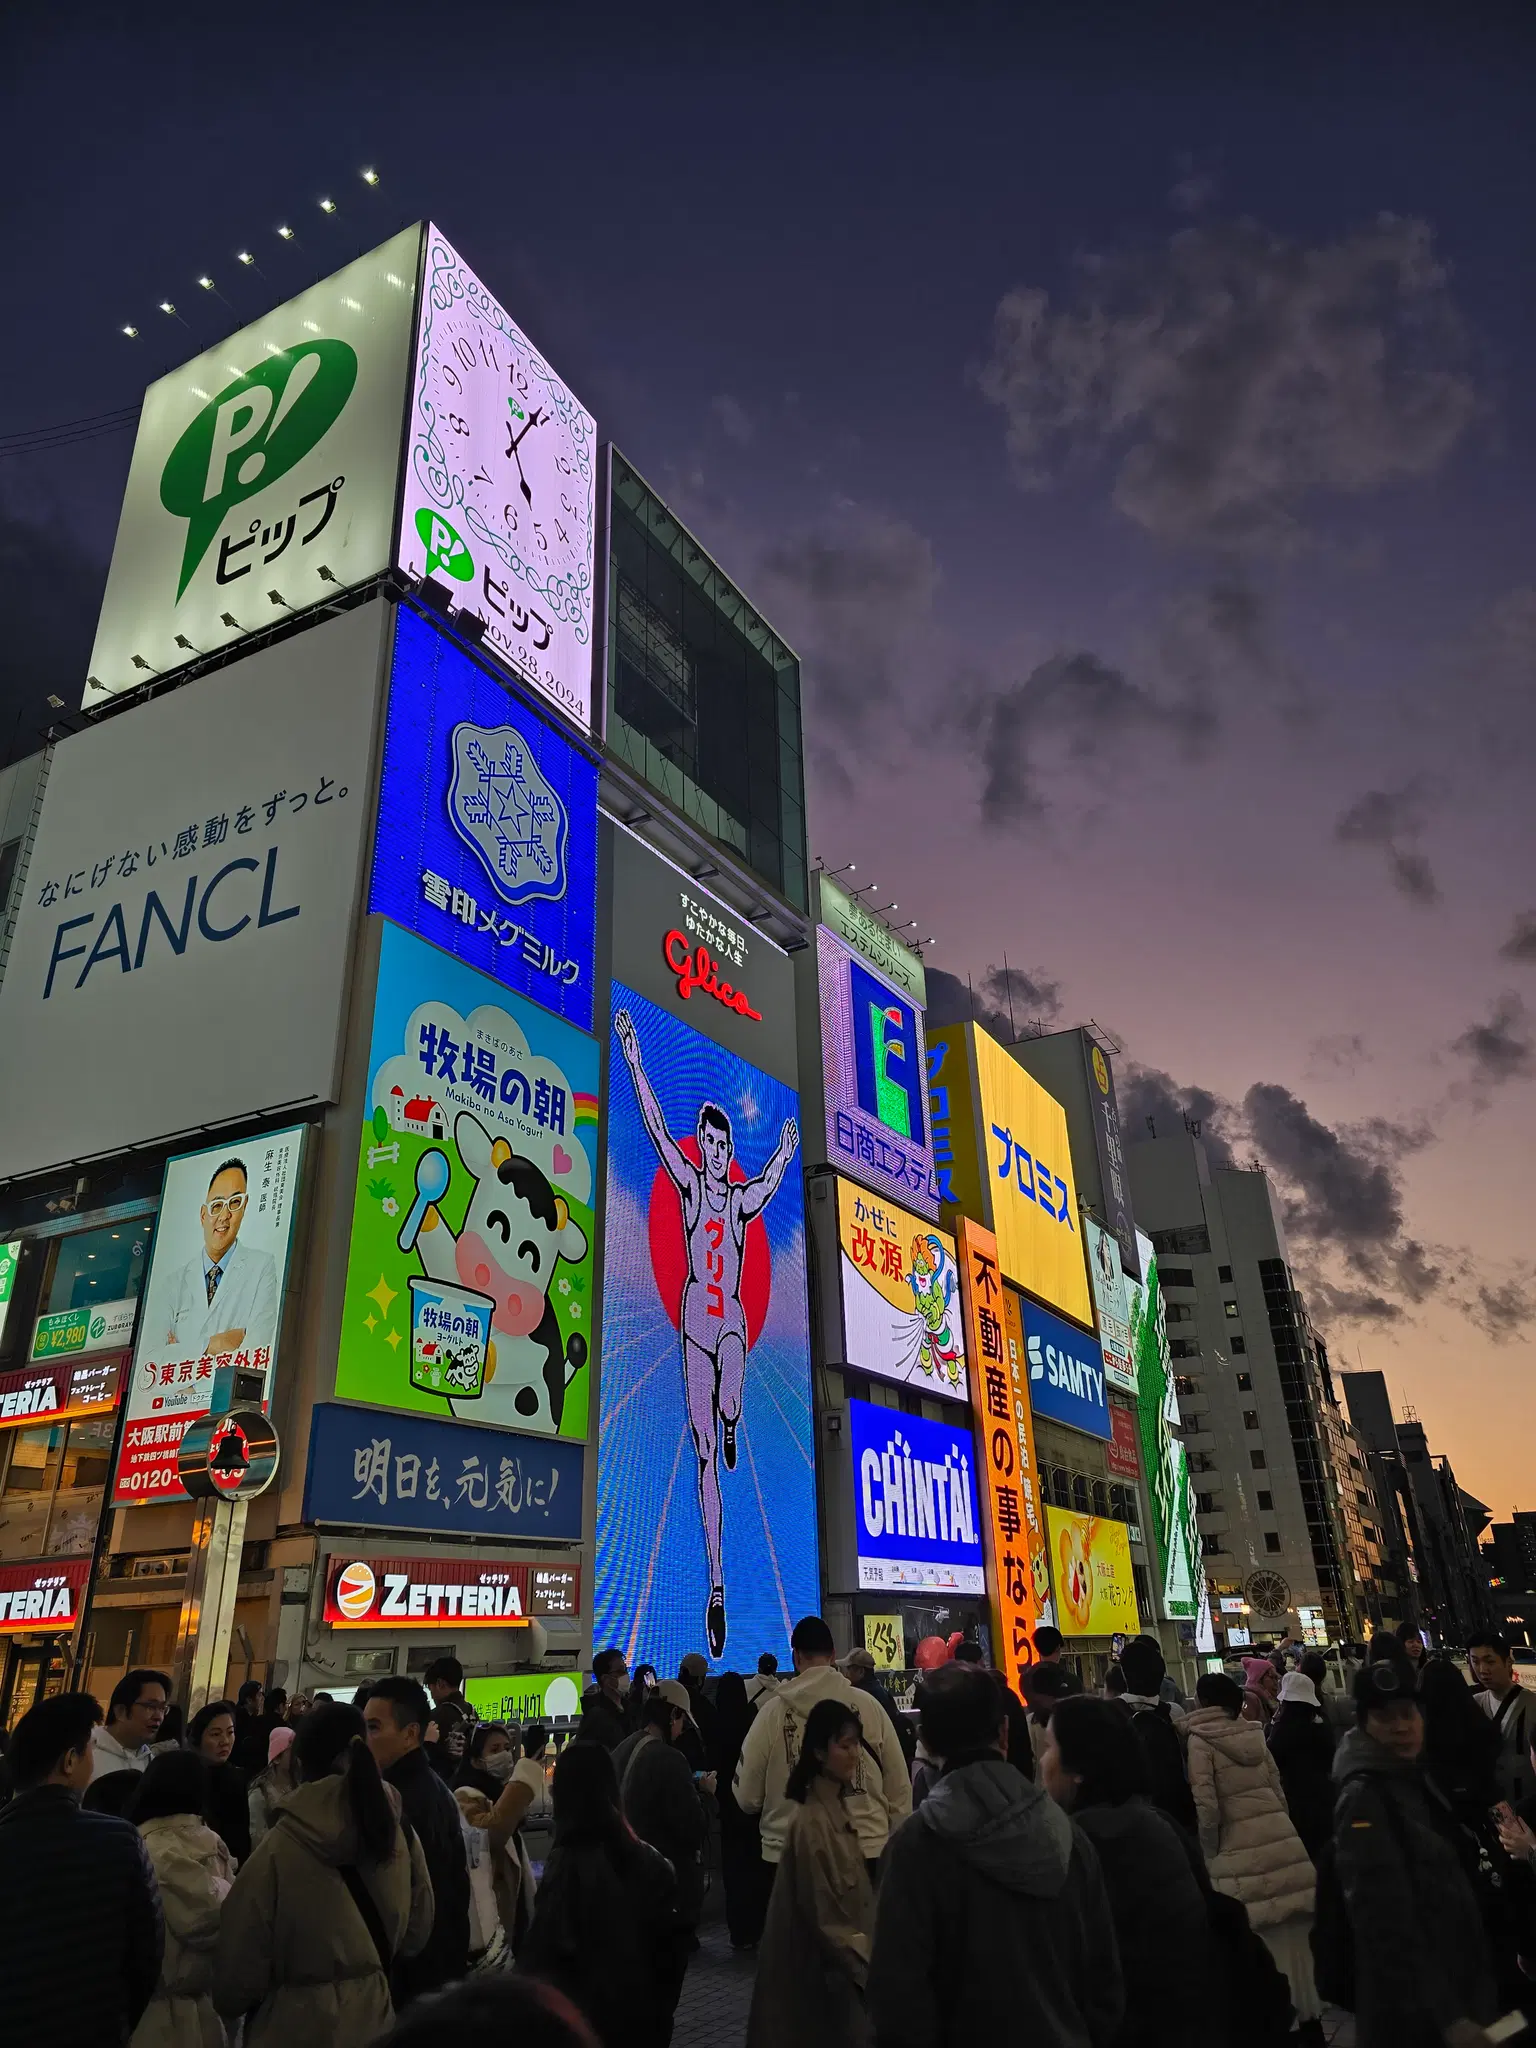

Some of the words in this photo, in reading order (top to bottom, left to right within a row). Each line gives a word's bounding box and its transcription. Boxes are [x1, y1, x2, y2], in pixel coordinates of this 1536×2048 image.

[451, 337, 477, 372] 10
[478, 339, 500, 372] 11
[442, 365, 463, 395] 9
[507, 363, 528, 400] 12
[449, 413, 470, 437] 8
[473, 465, 494, 485] 7
[553, 454, 571, 476] 2
[504, 504, 518, 531] 6
[560, 493, 577, 520] 3
[215, 475, 345, 585] ピップ
[533, 522, 547, 551] 5
[554, 518, 570, 544] 4
[483, 563, 554, 651] ピップ
[38, 776, 350, 908] なにげない感動をずっと。
[42, 846, 301, 1000] FANCL
[422, 869, 580, 985] 雪印メグミルク
[680, 892, 749, 955] すこやかな毎日、
[685, 914, 743, 967] ゆたかな人生
[664, 928, 763, 1021] Glico
[476, 1028, 524, 1061] まきばのあさ
[419, 1021, 567, 1137] 牧場の朝
[445, 1086, 482, 1113] Makiba
[484, 1106, 496, 1117] no
[497, 1109, 515, 1126] Asa
[516, 1116, 545, 1140] Yogurt
[991, 1122, 1075, 1233] プロミス
[853, 1195, 898, 1239] かぜに
[703, 1217, 726, 1319] グリコ
[849, 1223, 905, 1284] 改源
[51, 1325, 86, 1348] ¥2,980
[423, 1306, 480, 1341] 牧場の朝
[436, 1332, 463, 1348] ヨーグルト
[1045, 1343, 1104, 1408] SAMTY
[83, 1391, 113, 1405] コーヒー
[164, 1395, 188, 1407] YouTube
[973, 1248, 1034, 1675] 不動産の事なら
[131, 1468, 184, 1491] 0120-
[380, 1573, 523, 1617] ZETTERIA
[479, 1573, 510, 1584] ゼッテリア
[547, 1599, 573, 1610] コーヒー
